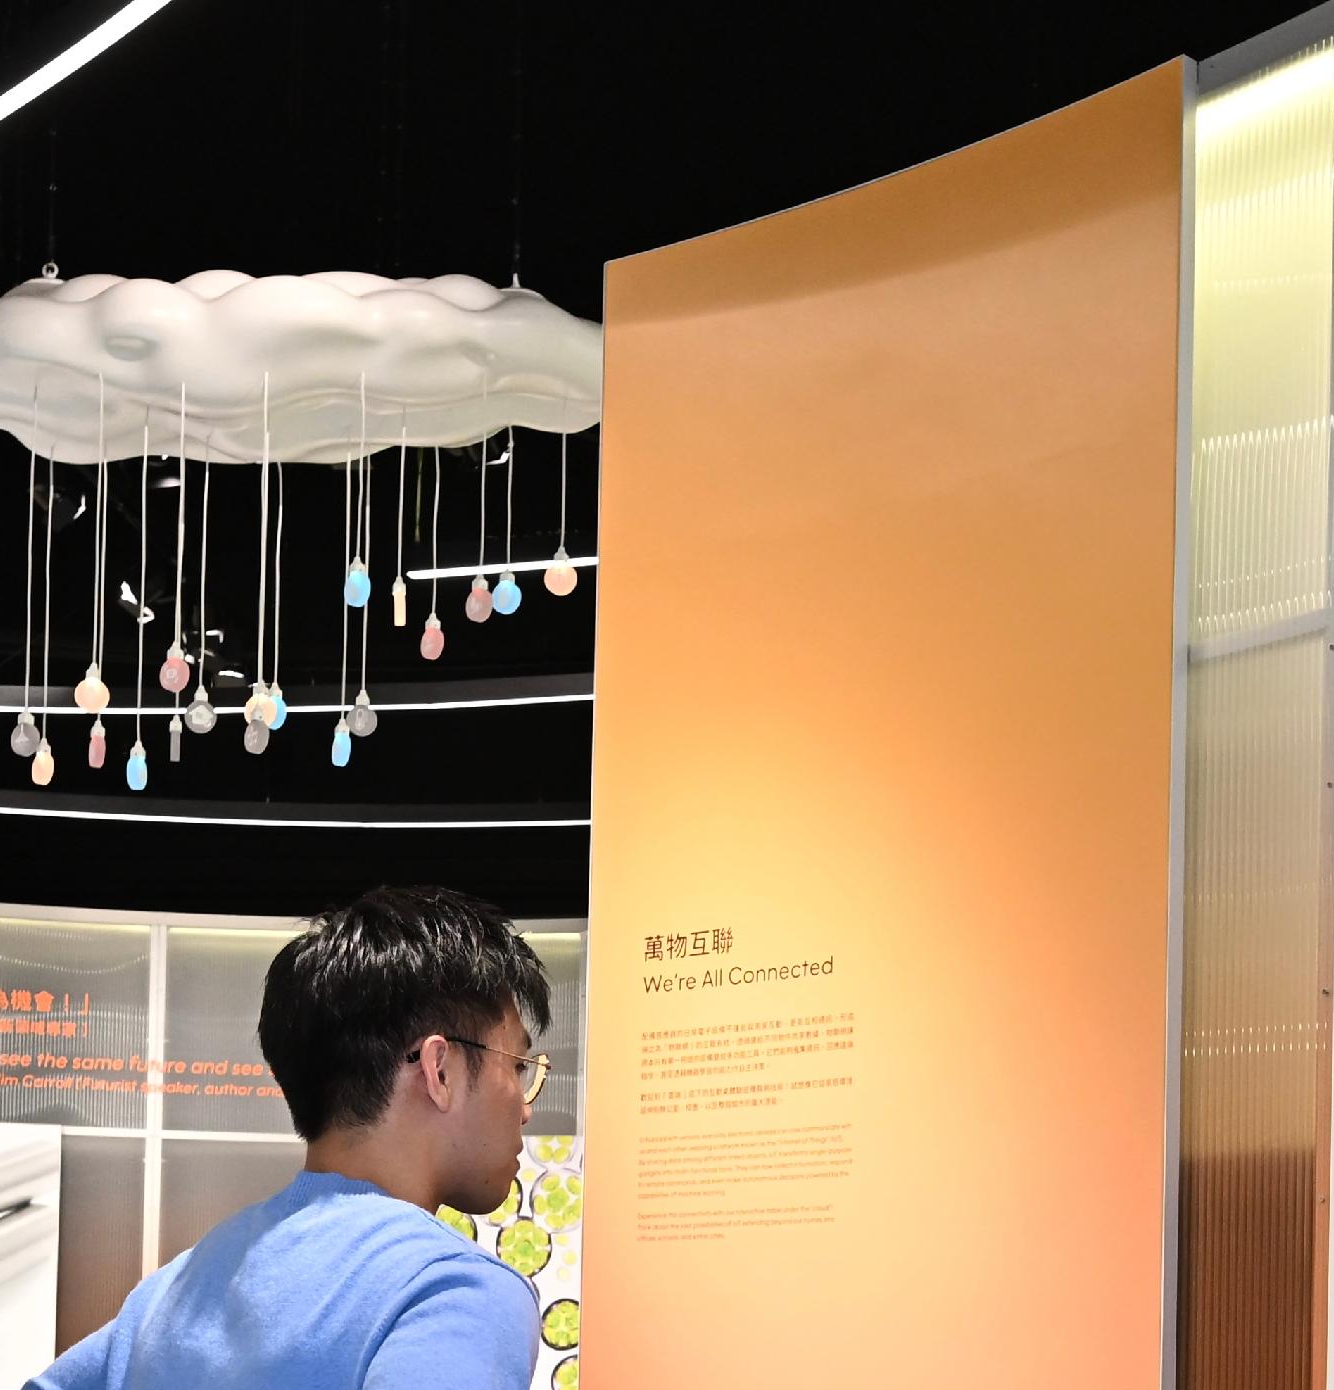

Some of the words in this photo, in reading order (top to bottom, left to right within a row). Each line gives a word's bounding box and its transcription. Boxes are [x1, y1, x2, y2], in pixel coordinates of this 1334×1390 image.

[643, 926, 734, 962] 萬物互聯
[643, 973, 697, 993] We're
[702, 968, 723, 988] All
[728, 956, 834, 986] Connected
[37, 1052, 68, 1070] the
[72, 1055, 124, 1072] same
[191, 1060, 229, 1076] and
[232, 1062, 264, 1077] see
[204, 1082, 254, 1097] author
